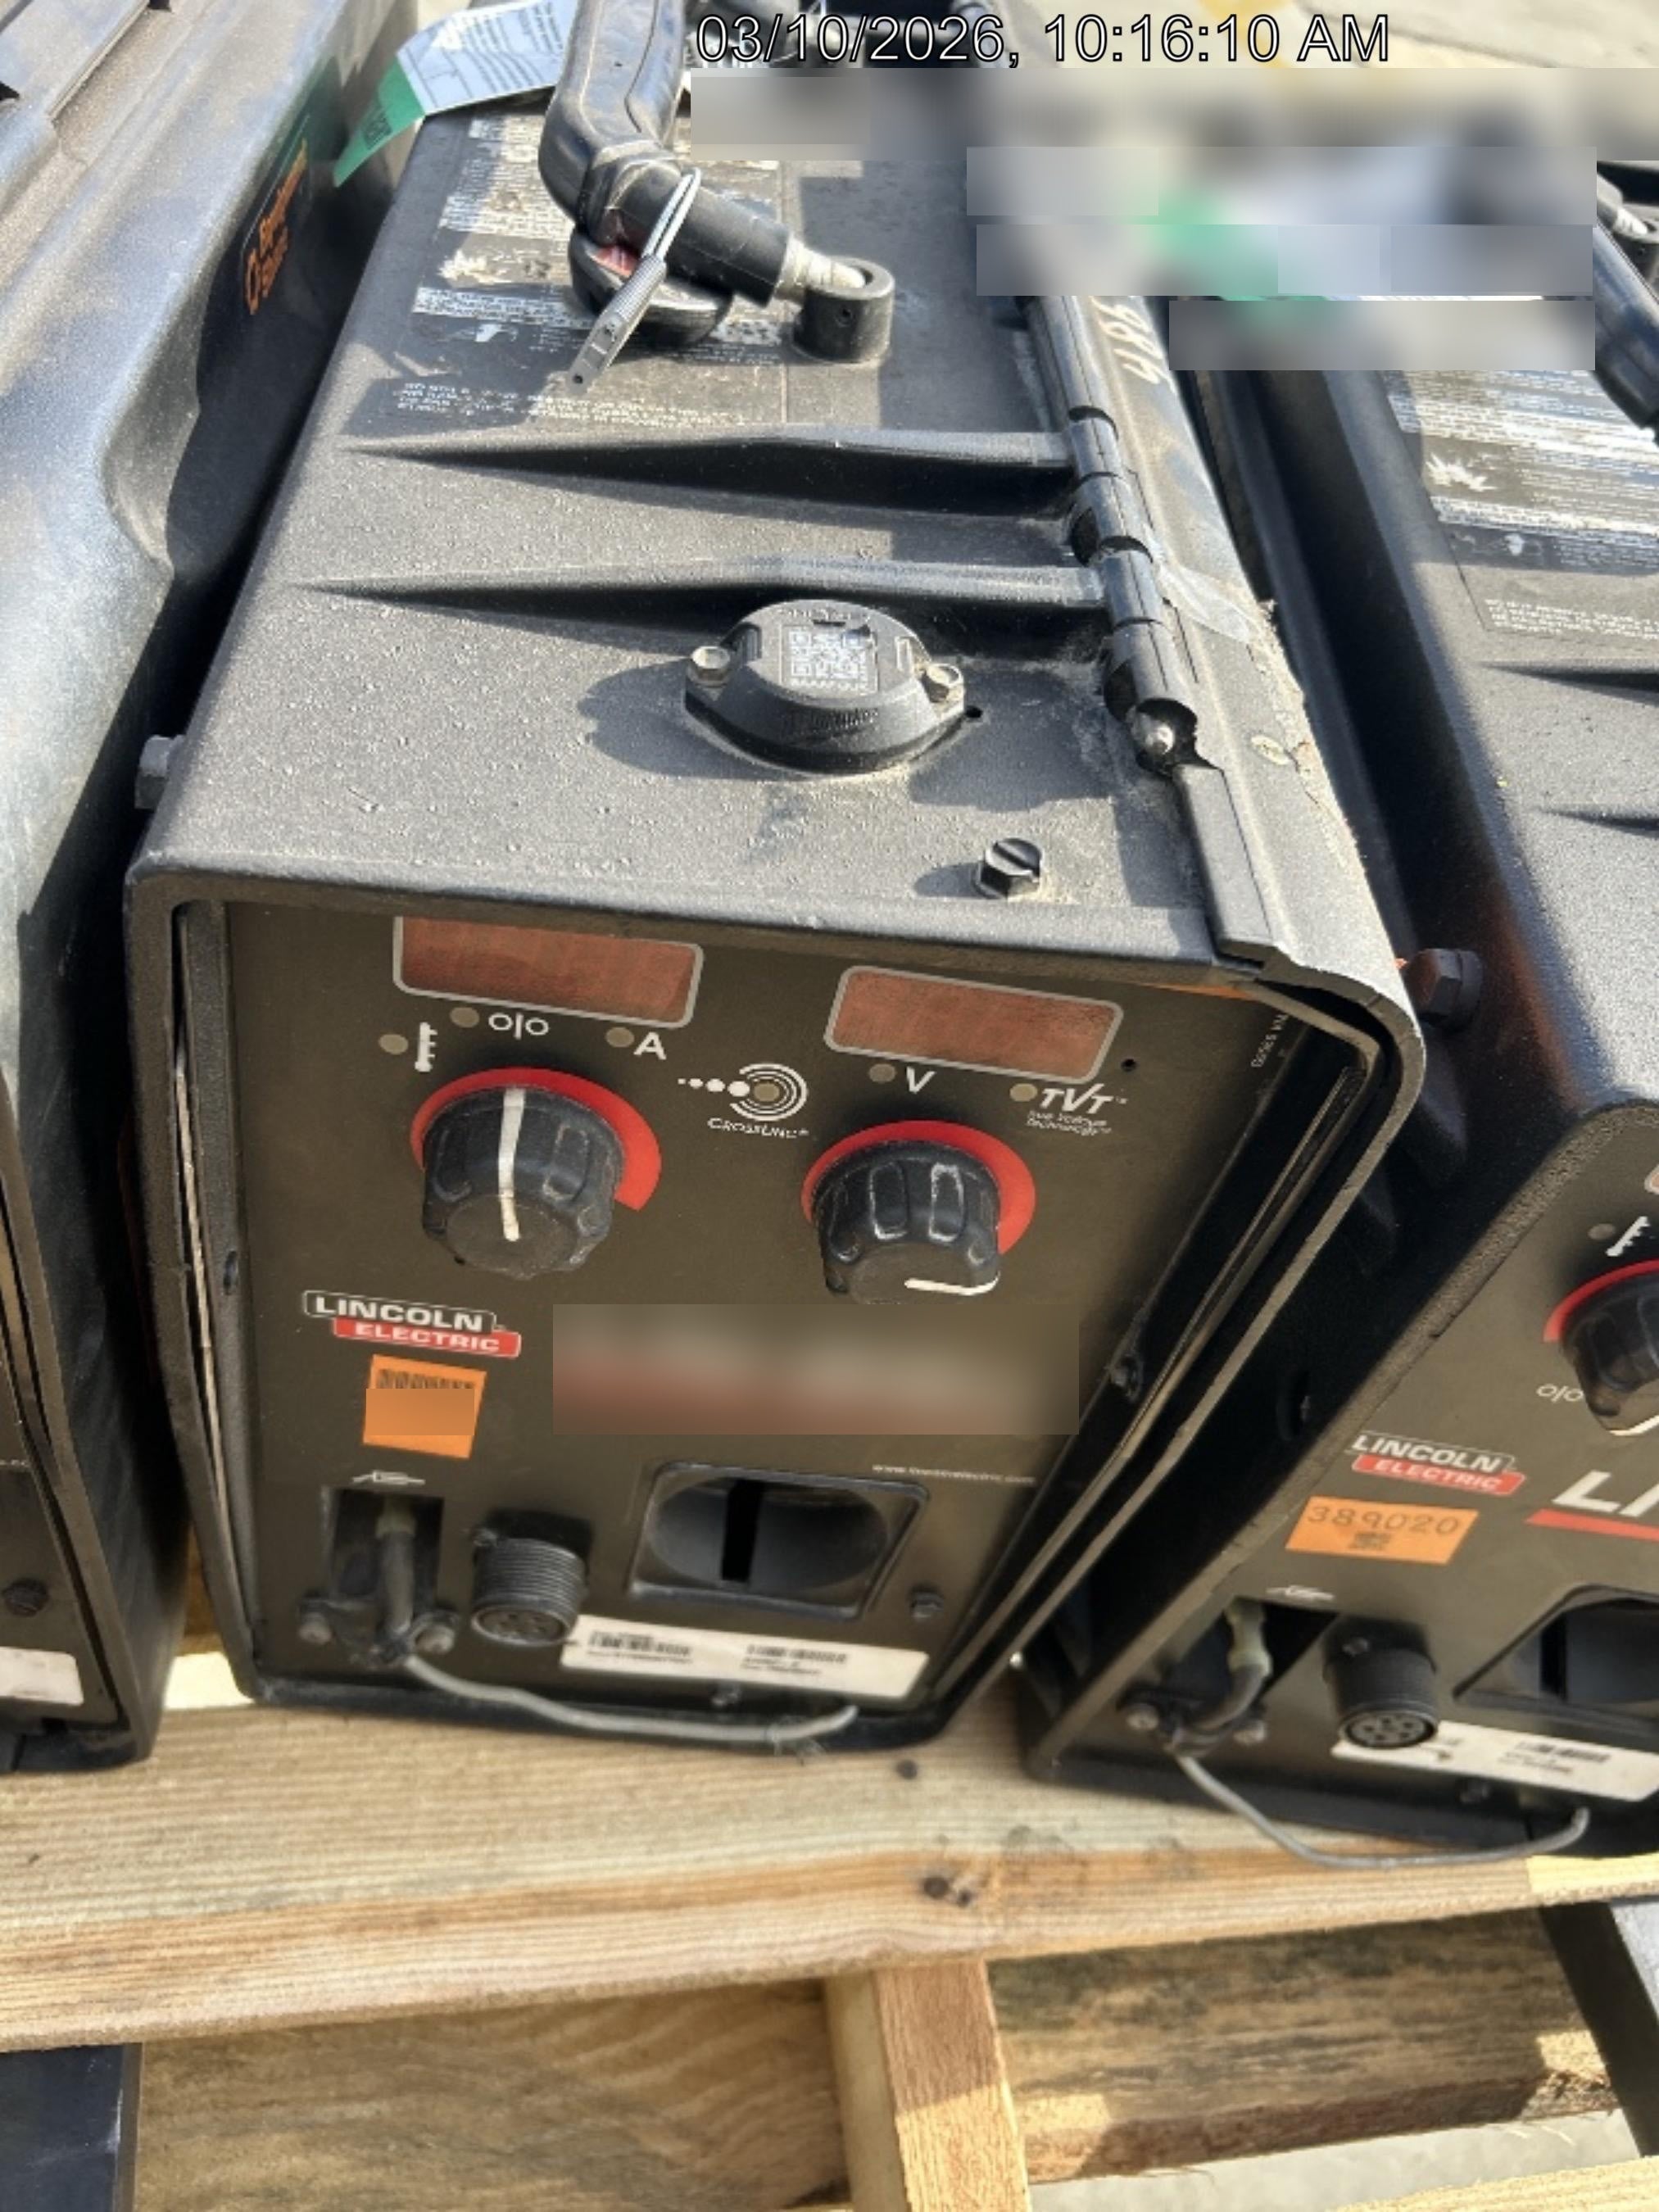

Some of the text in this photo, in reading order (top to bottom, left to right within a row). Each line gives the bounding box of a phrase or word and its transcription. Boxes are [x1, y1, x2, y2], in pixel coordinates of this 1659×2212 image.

[633, 1031, 667, 1061] A
[906, 1066, 936, 1094] V
[315, 1296, 483, 1332] LINCOLN
[354, 1321, 500, 1352] ELECTRIC
[1352, 1435, 1502, 1473] LINCOLN
[1373, 1458, 1503, 1490] ELECTRIC
[1307, 1505, 1460, 1537] 389020
